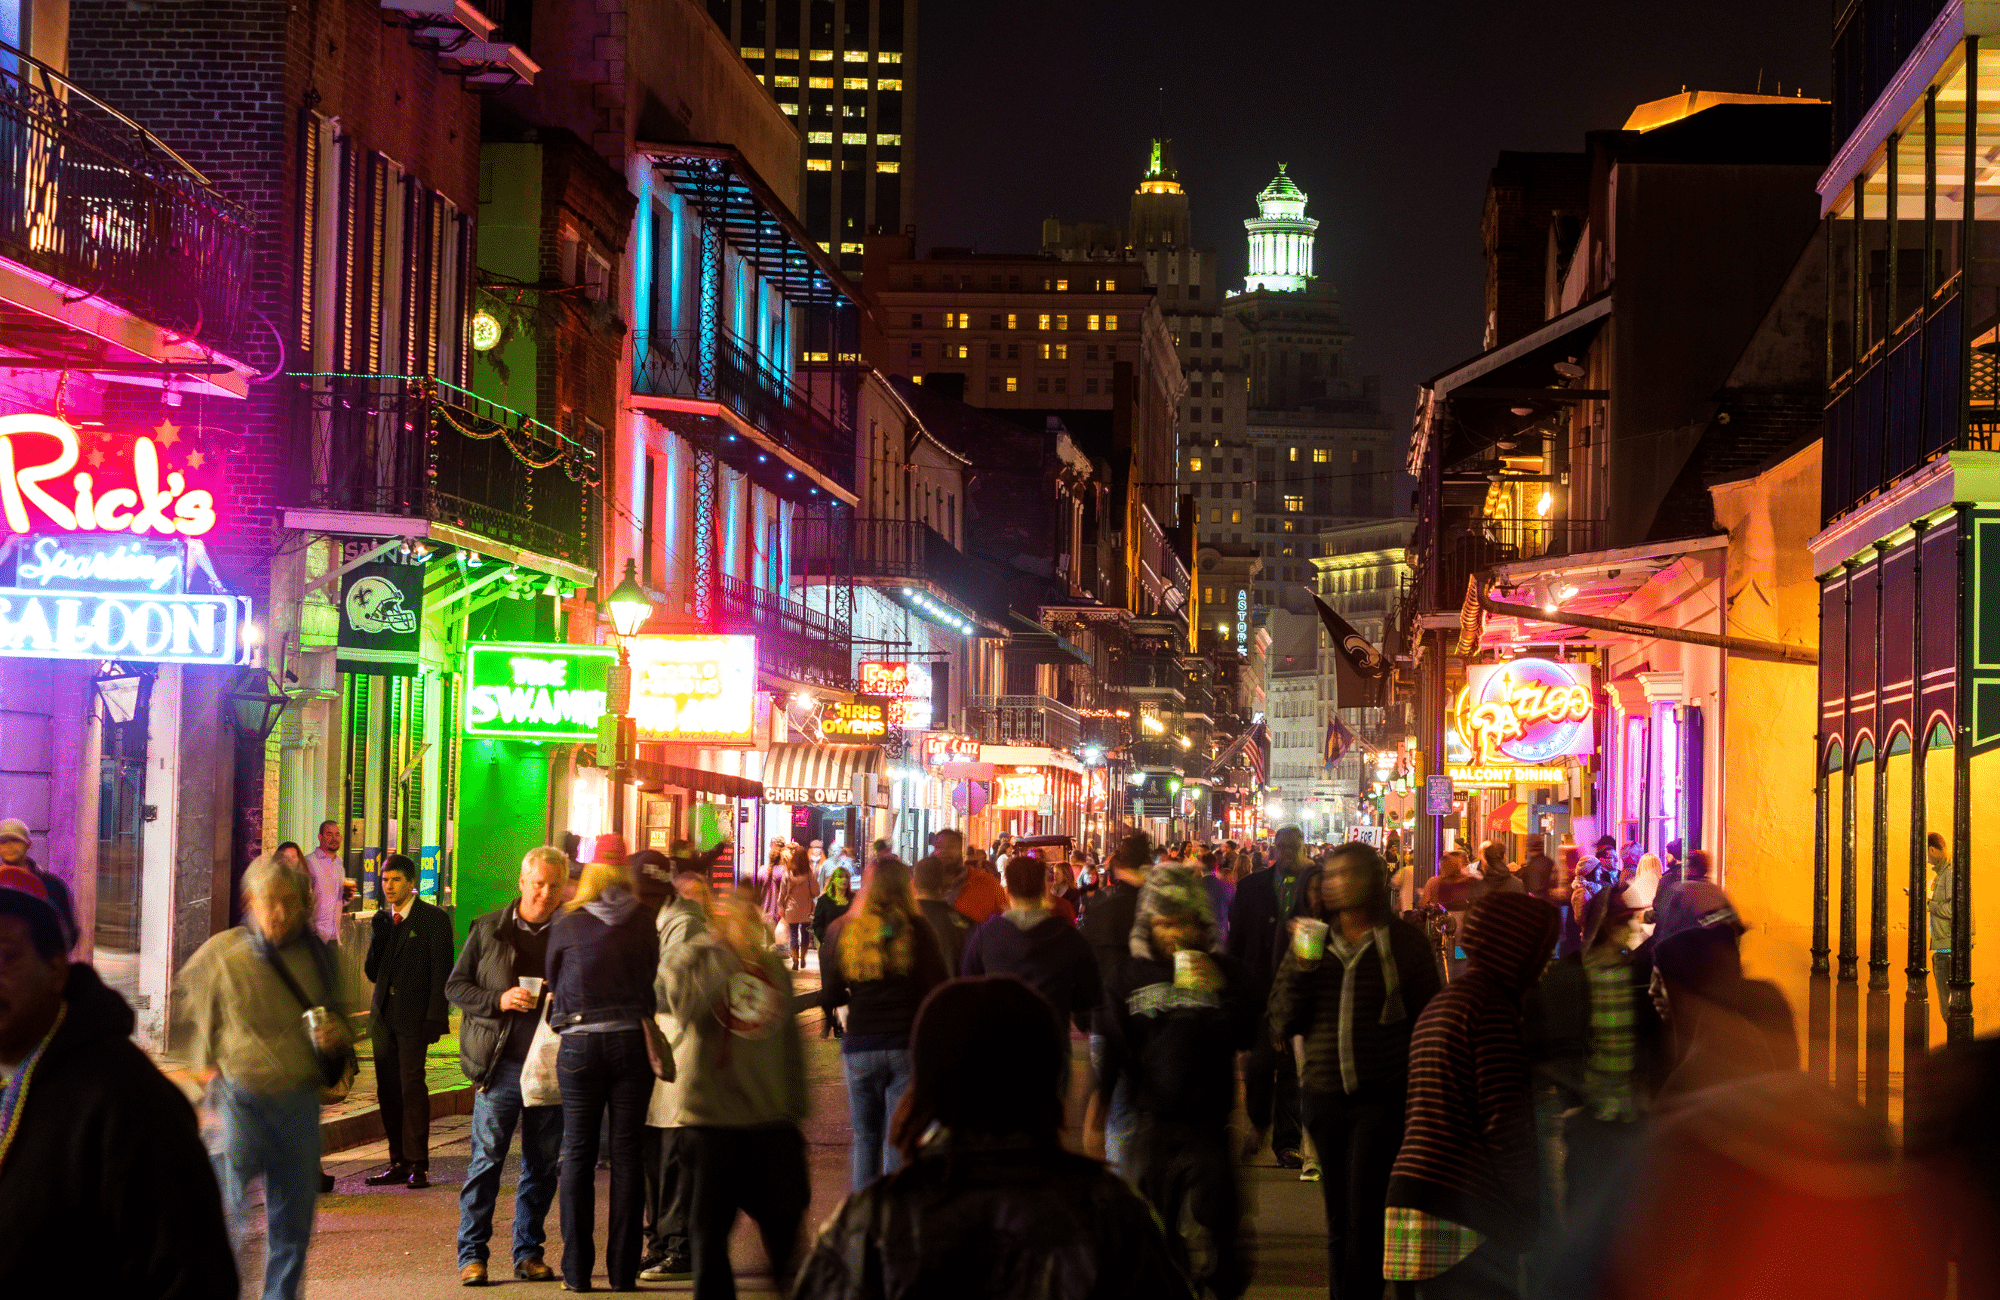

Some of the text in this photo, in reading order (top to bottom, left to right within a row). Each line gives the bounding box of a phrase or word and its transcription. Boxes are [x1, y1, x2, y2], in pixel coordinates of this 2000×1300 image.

[0, 414, 216, 535] Rick's
[1237, 589, 1247, 643] ASTOR
[508, 658, 567, 686] THE
[831, 704, 882, 719] CHRIS
[821, 719, 885, 735] OWENS
[952, 739, 979, 754] CATZ
[1449, 768, 1563, 782] BALCONY DINING
[765, 788, 853, 803] CHRIS OWEN
[1361, 831, 1372, 843] FOR
